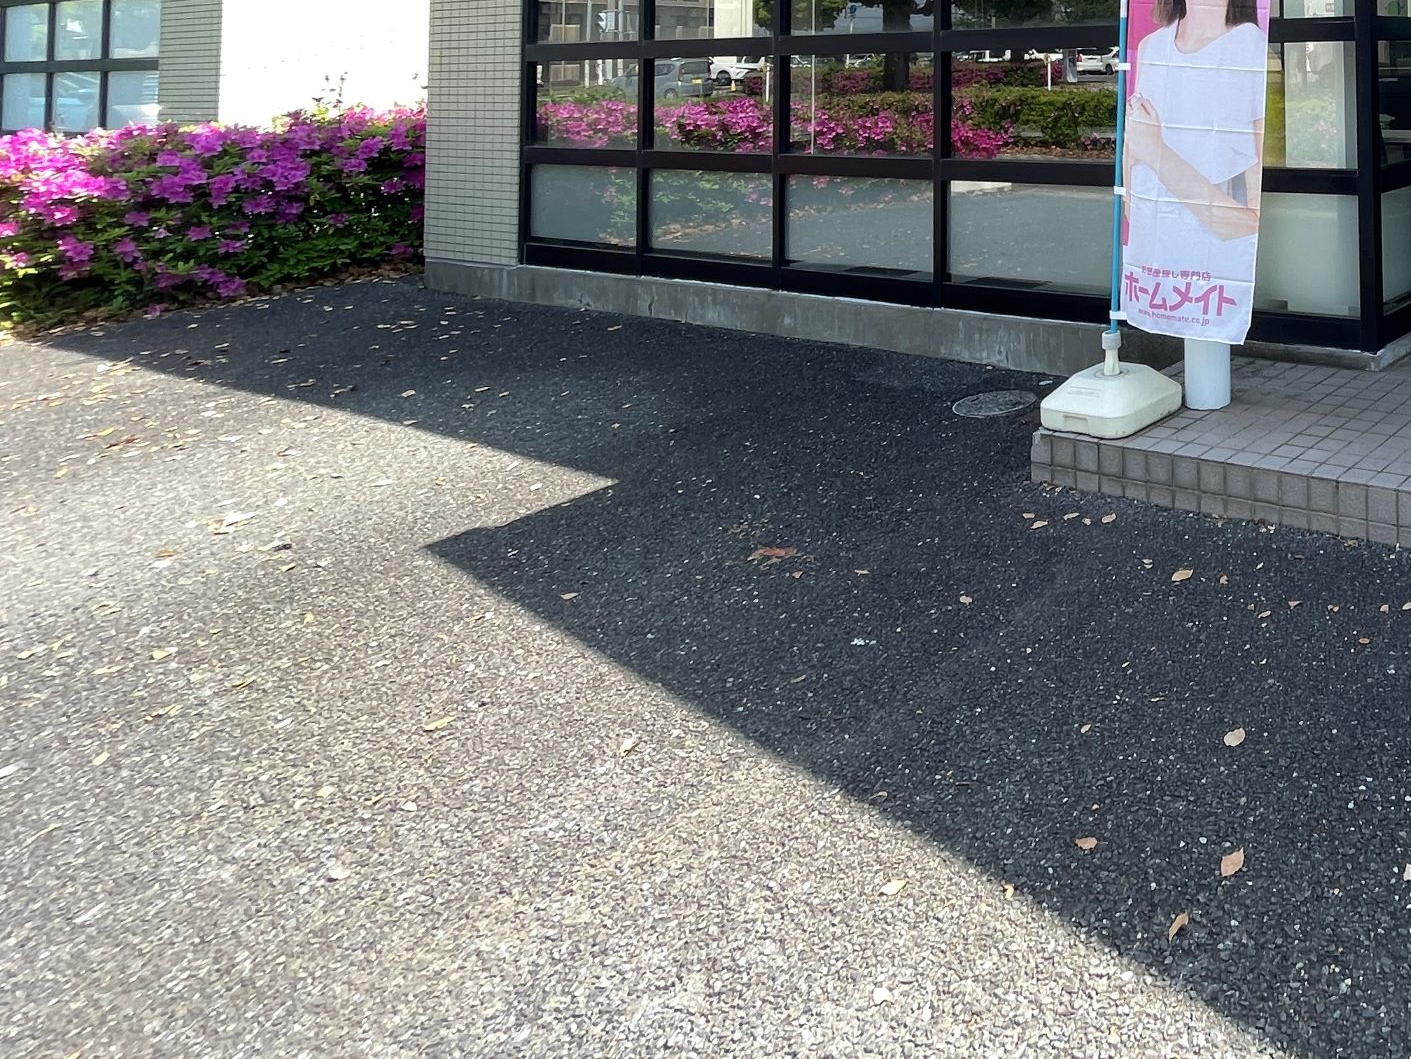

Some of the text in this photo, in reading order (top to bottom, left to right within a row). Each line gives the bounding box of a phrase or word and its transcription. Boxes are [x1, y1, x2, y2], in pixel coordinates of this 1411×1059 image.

[1124, 271, 1238, 317] ホームメイト
